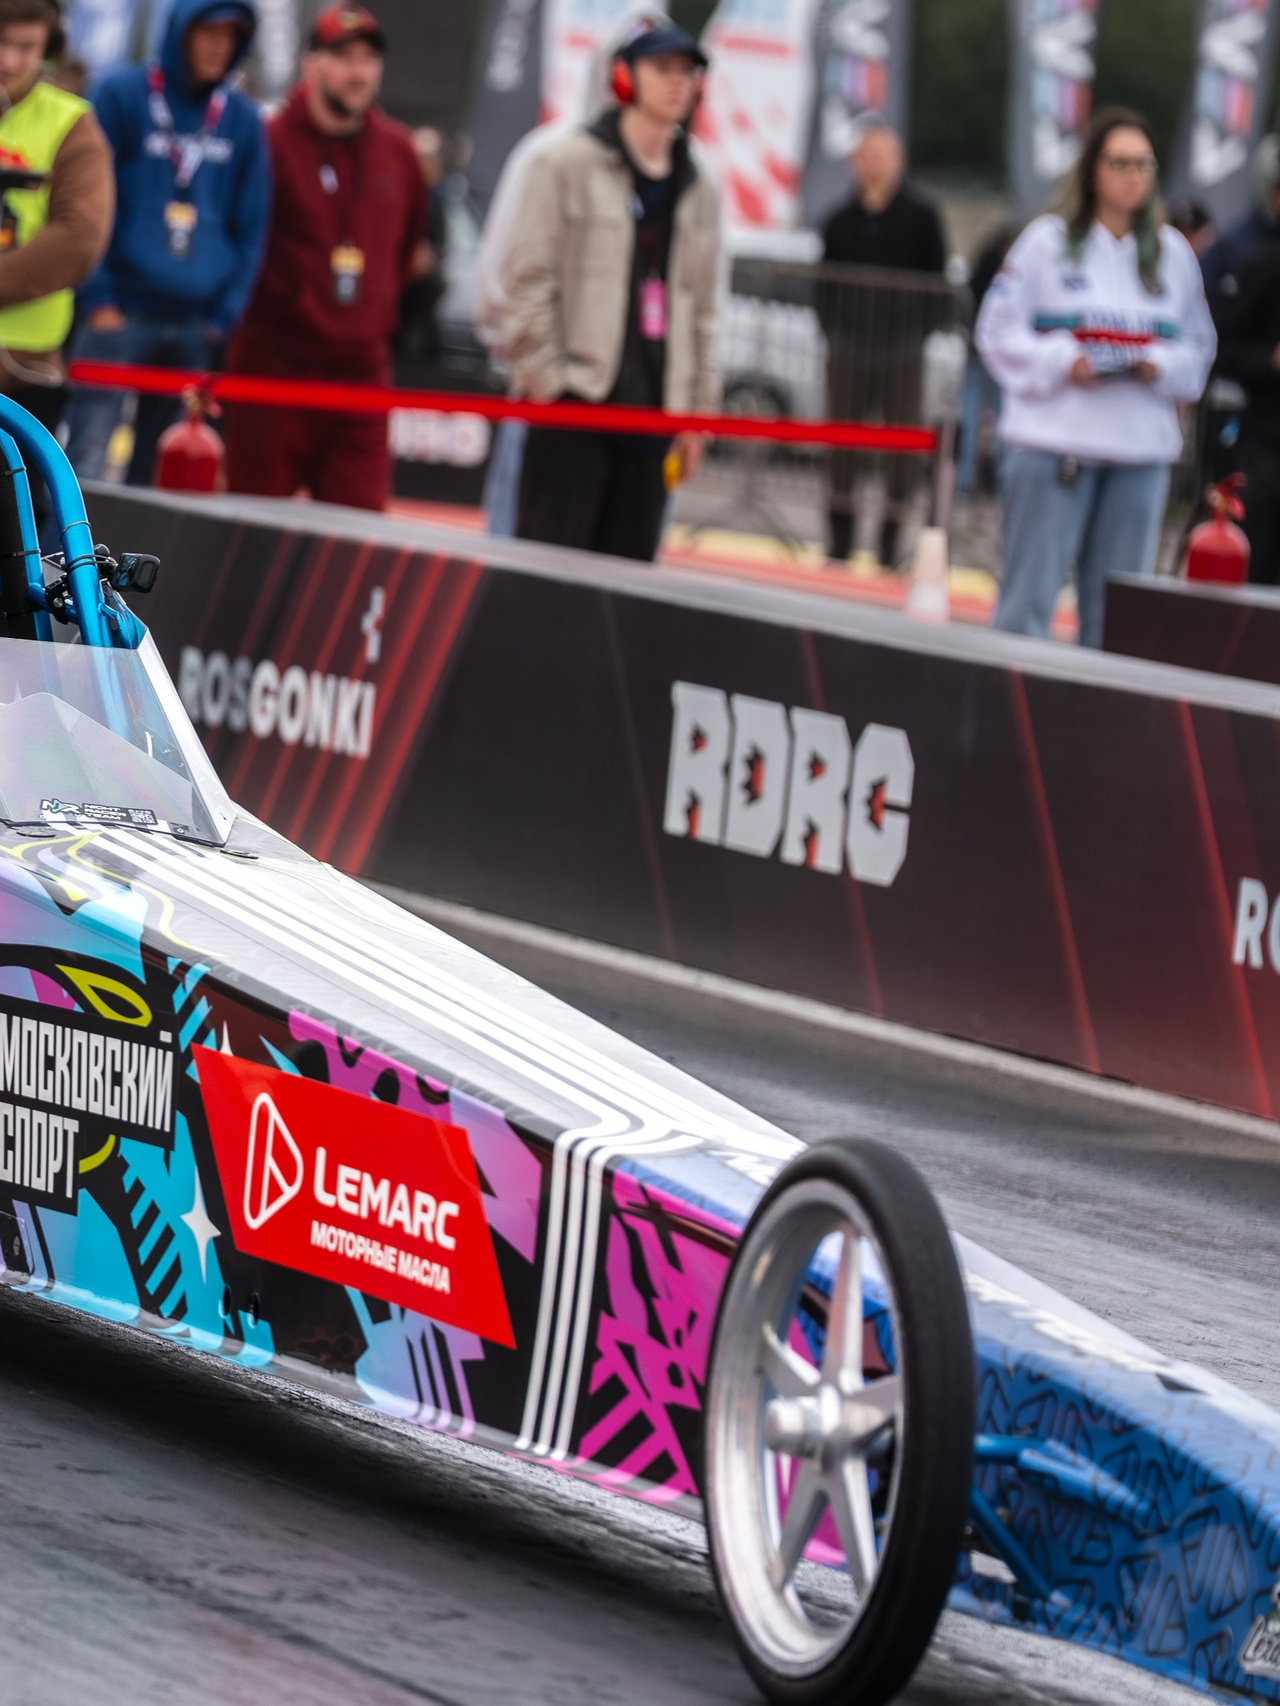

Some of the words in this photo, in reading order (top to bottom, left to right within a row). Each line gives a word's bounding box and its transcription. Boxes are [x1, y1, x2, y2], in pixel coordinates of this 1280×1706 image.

[179, 644, 376, 760] ROSGONKI
[84, 803, 121, 812] NIGHT
[84, 808, 127, 817] RACER
[85, 813, 122, 821] TEAM
[663, 679, 915, 888] RDRC
[1232, 876, 1280, 976] R
[313, 1146, 460, 1251] LEMARC
[310, 1220, 398, 1274] МОТОРНЫЕ
[397, 1250, 451, 1295] МАСЛА
